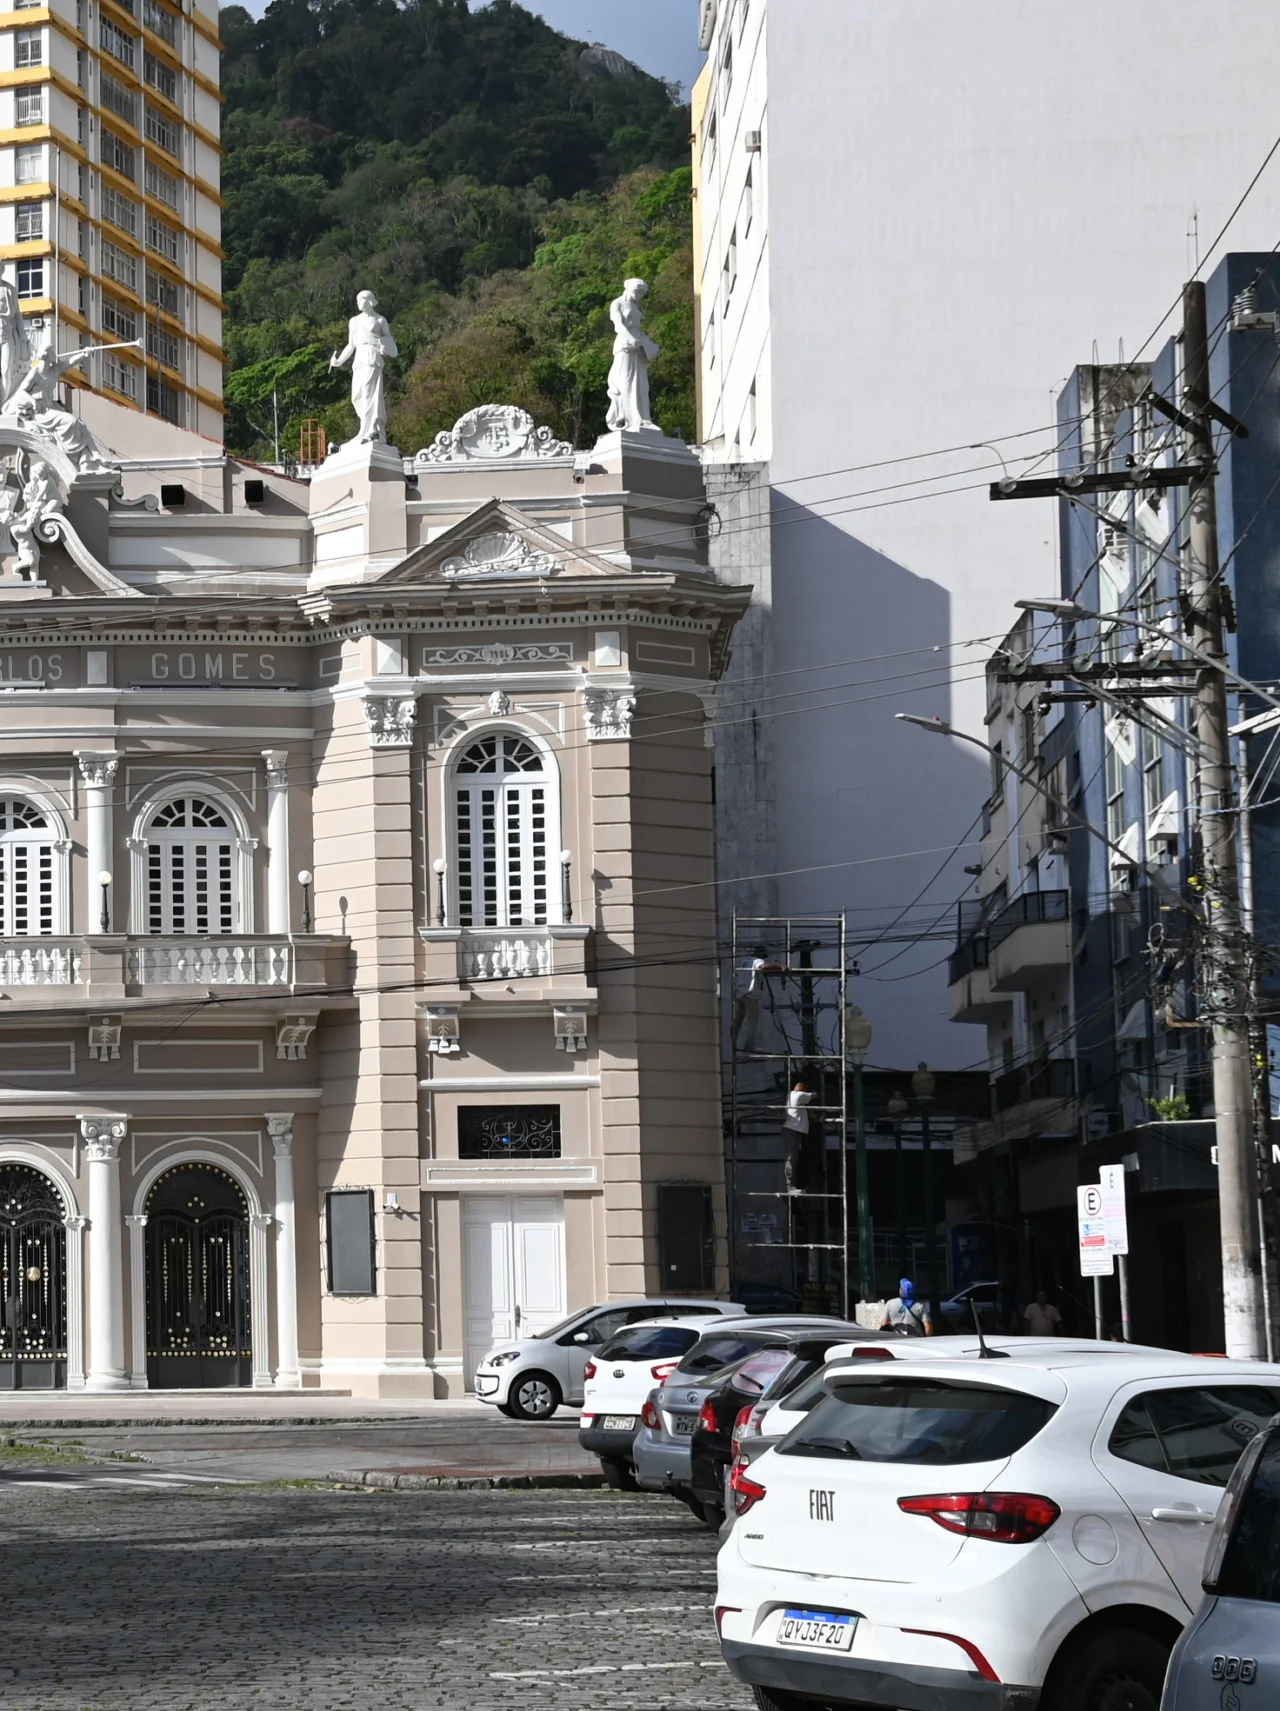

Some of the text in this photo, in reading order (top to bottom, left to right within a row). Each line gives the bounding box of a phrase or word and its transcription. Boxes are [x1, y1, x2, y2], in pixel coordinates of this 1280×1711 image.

[151, 652, 276, 681] GOMES
[1088, 1193, 1096, 1210] E
[809, 1489, 836, 1522] FIAT
